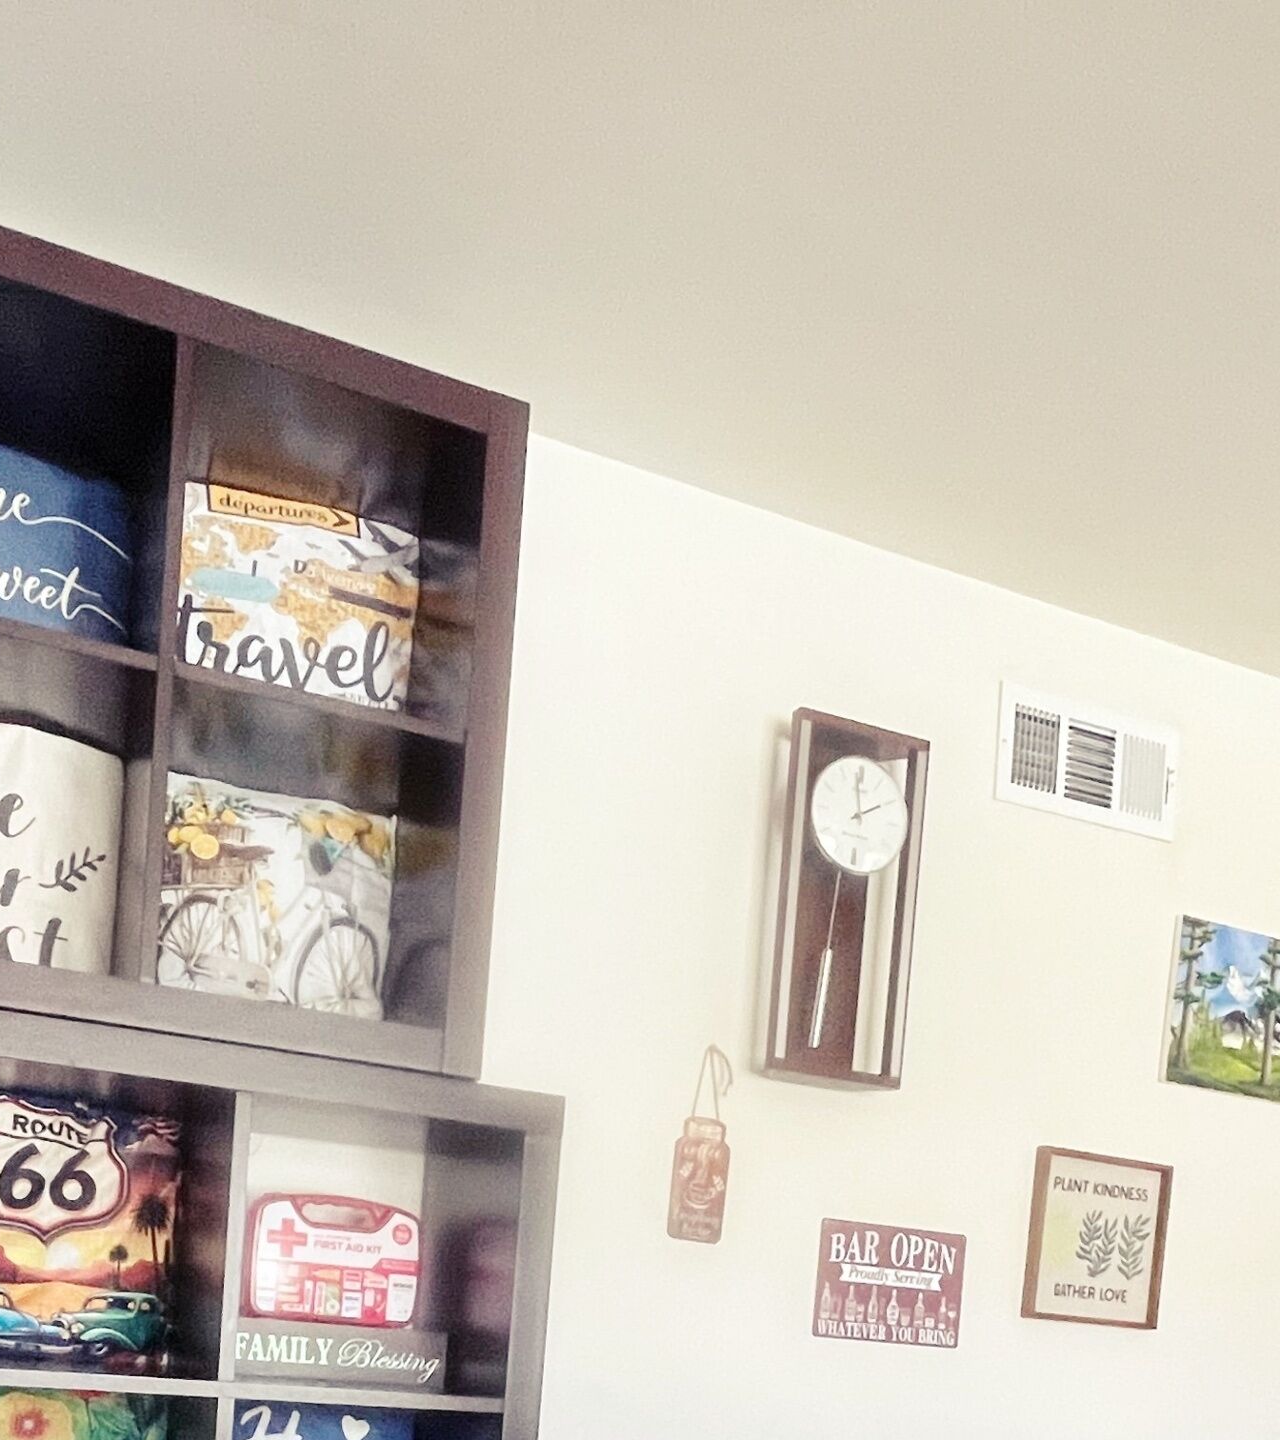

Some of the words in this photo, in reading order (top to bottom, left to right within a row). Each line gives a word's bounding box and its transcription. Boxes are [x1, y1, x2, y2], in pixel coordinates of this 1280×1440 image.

[219, 493, 328, 523] departures
[176, 594, 395, 701] travel
[12, 1113, 90, 1145] ROUTE
[1053, 1176, 1090, 1194] PLANT
[1092, 1183, 1149, 1202] KINDNESS
[313, 1239, 344, 1251] FIRST
[345, 1242, 364, 1253] AID
[366, 1245, 382, 1255] KIT
[829, 1230, 880, 1265] BAR
[890, 1232, 957, 1275] OPEN
[848, 1267, 889, 1284] Proudly
[894, 1270, 933, 1287] Serving
[1053, 1283, 1096, 1300] GATHER
[1099, 1288, 1127, 1303] LOVE
[817, 1318, 886, 1342] WHATEVER
[891, 1325, 917, 1343] YOU
[918, 1327, 956, 1347] BRING
[235, 1331, 335, 1366] FAMILY
[336, 1337, 440, 1384] Blessing
